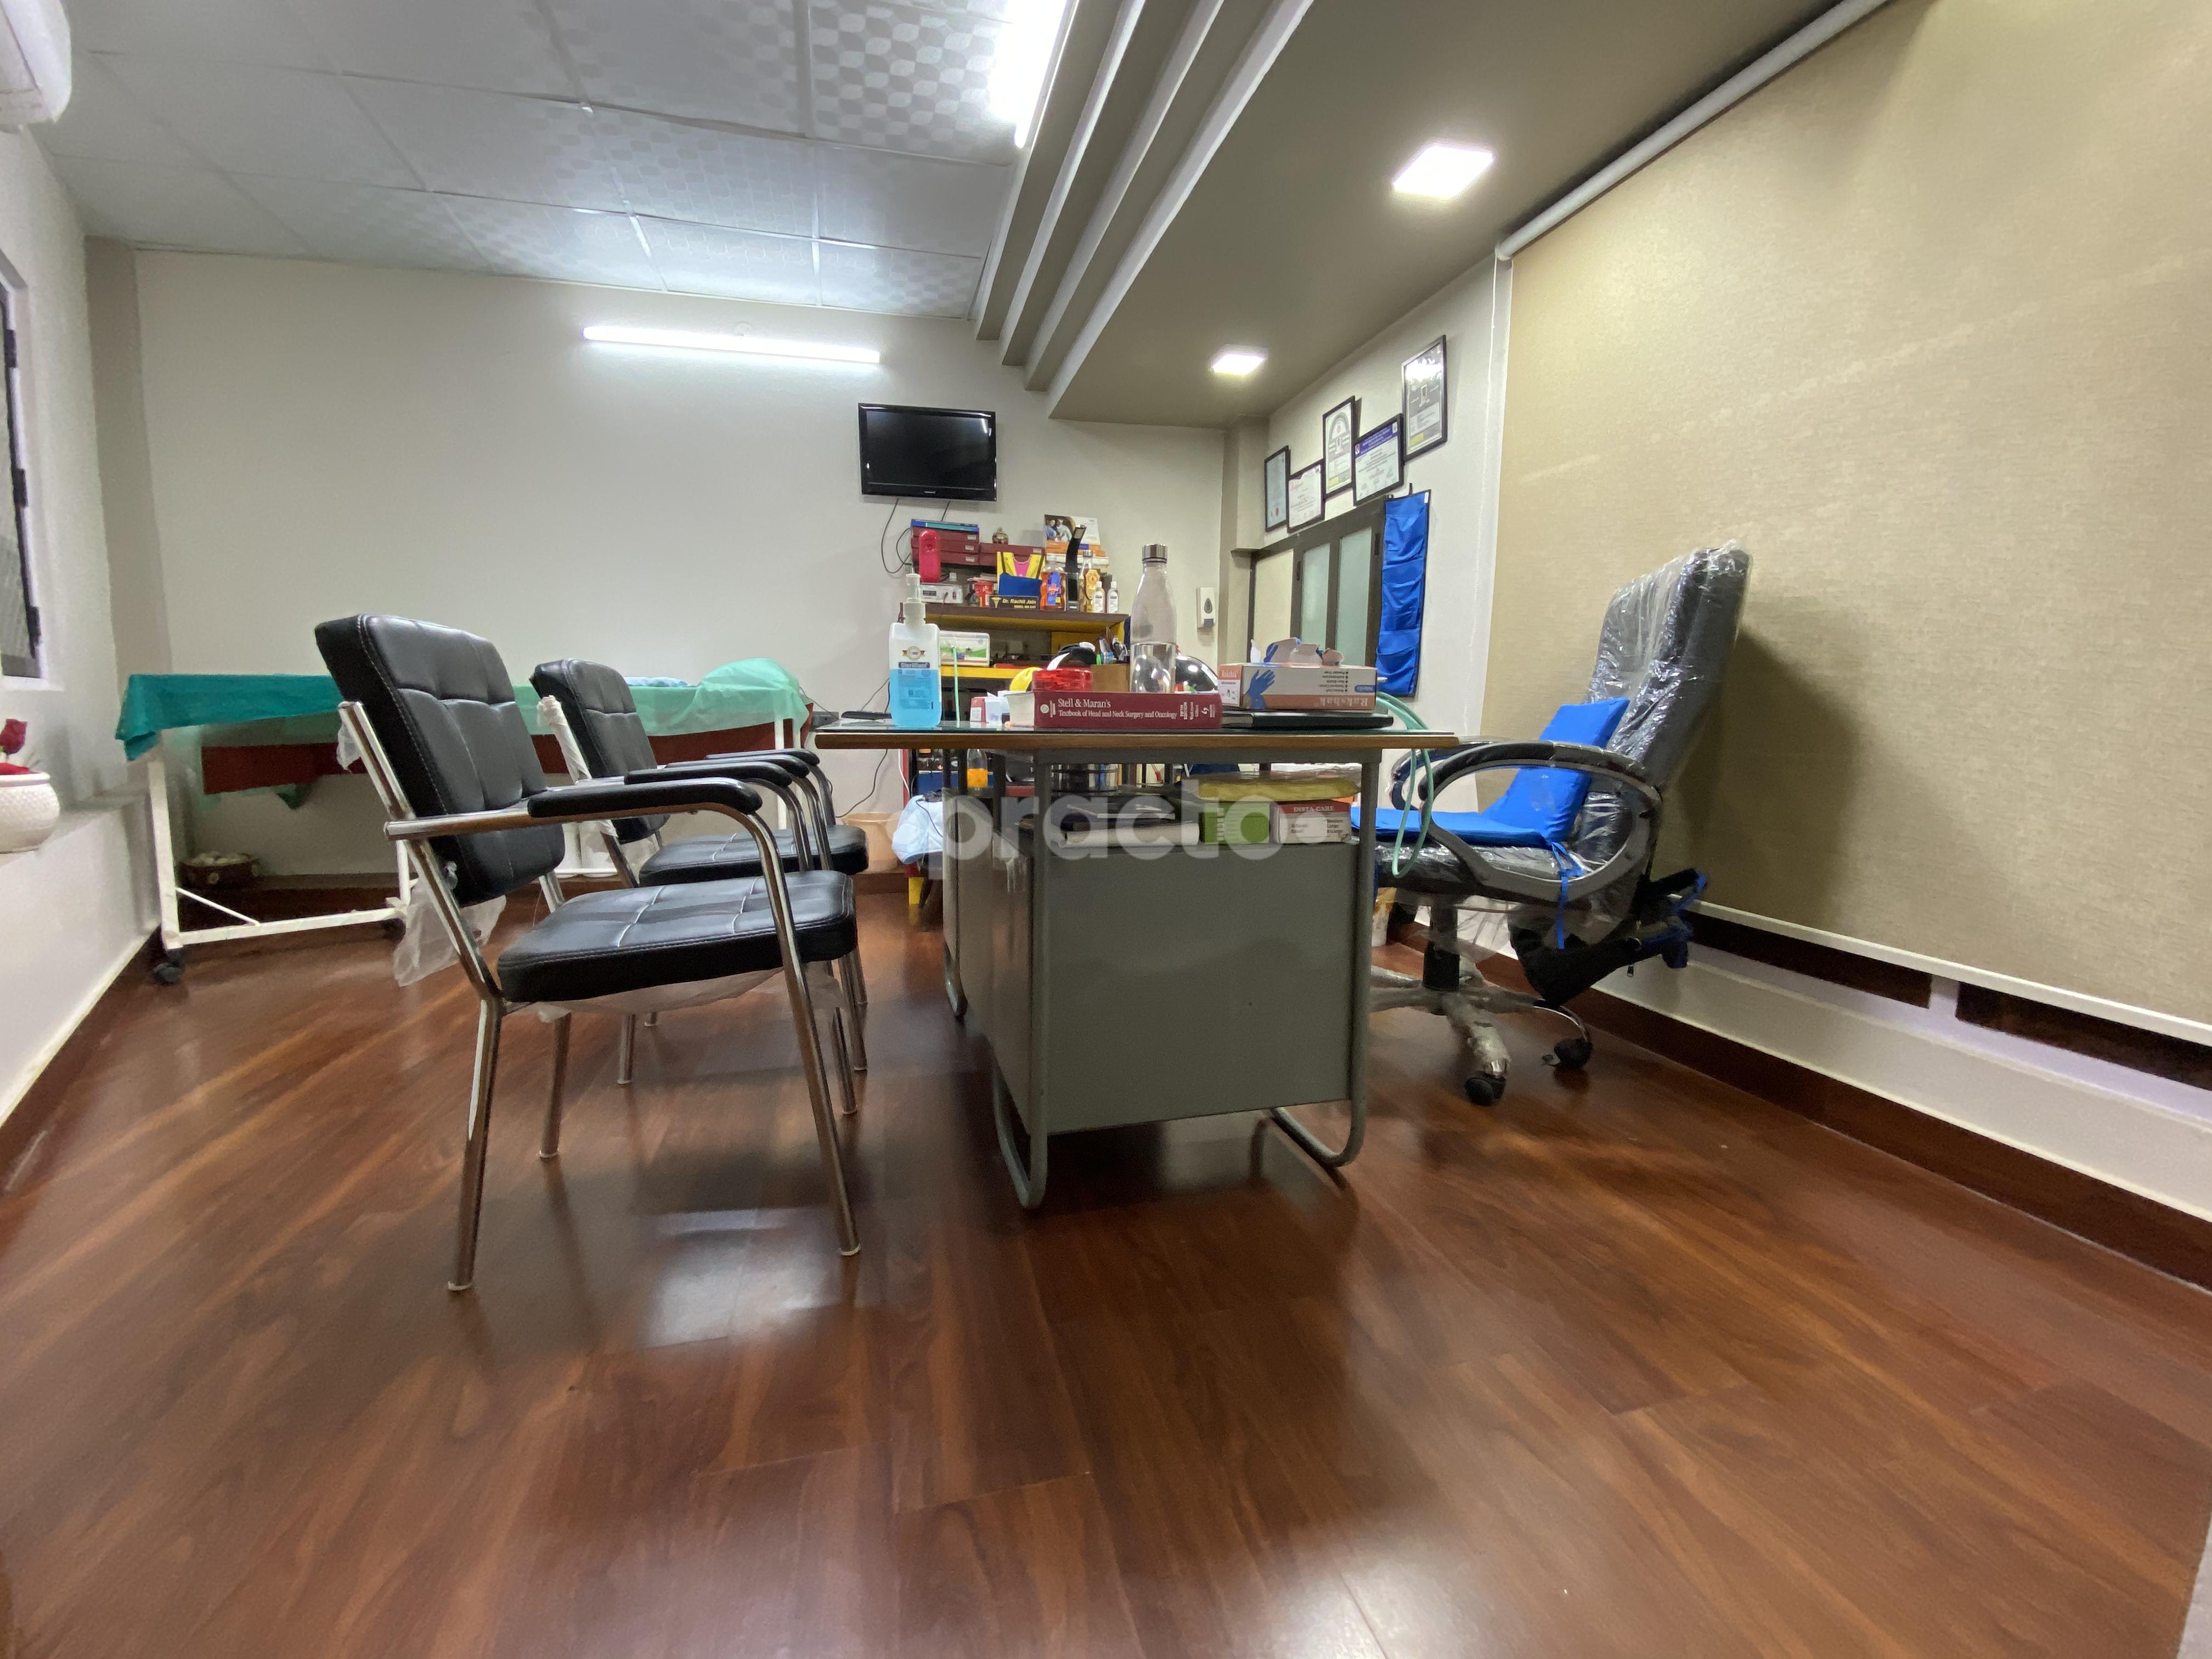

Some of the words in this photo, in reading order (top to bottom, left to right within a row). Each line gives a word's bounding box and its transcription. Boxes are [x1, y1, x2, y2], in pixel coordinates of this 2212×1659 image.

[1058, 698, 1074, 707] Stell
[1075, 698, 1082, 707] &
[1083, 698, 1111, 708] Maran's
[1319, 697, 1369, 707] Rakshak
[1125, 710, 1144, 719] Surgery
[1155, 711, 1177, 719] Oncology
